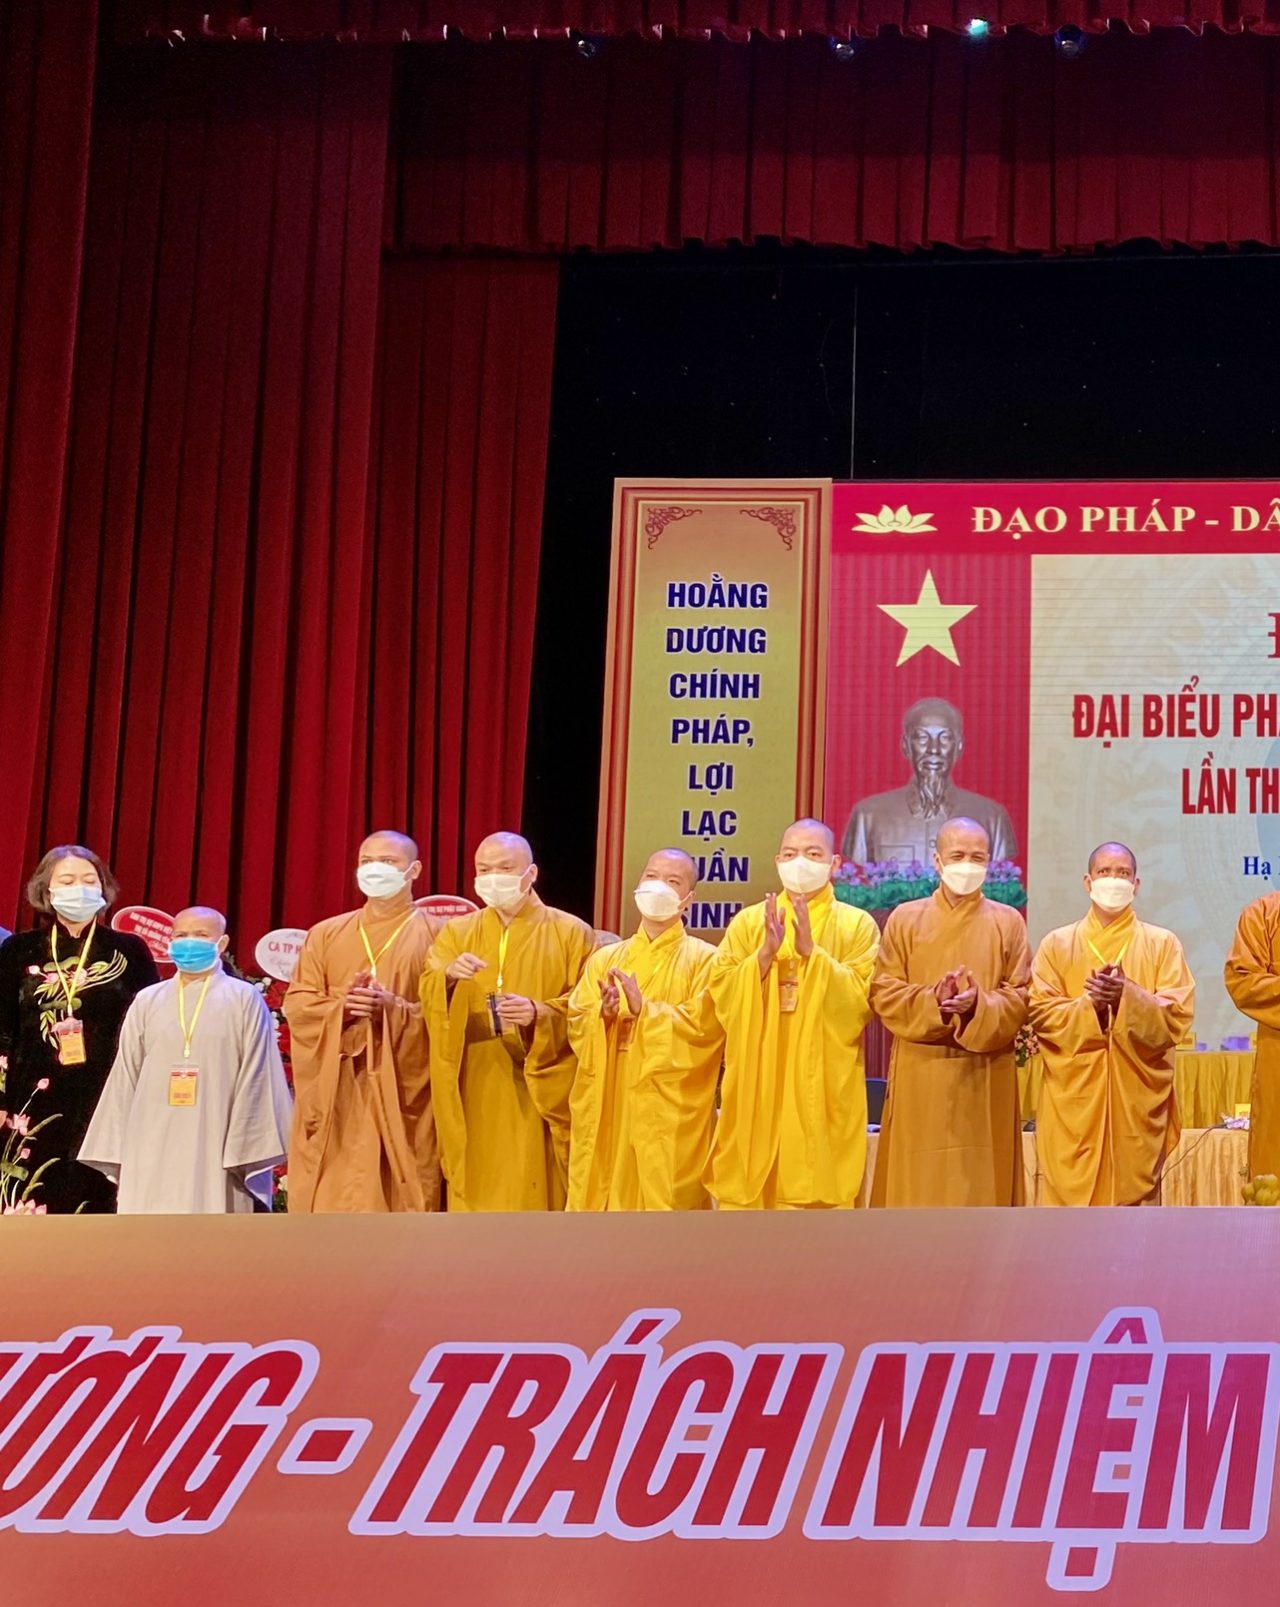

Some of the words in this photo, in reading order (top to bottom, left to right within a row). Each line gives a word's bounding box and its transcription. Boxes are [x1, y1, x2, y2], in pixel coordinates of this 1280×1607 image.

[971, 506, 1067, 540] ĐẠO
[1079, 498, 1196, 533] PHÁP
[667, 573, 768, 608] HOẰNG
[666, 625, 767, 653] DƯƠNG
[669, 669, 760, 699] CHÍNH
[1072, 694, 1130, 748] ĐẠI
[1142, 675, 1220, 738] BIỂU
[671, 714, 754, 747] PHÁP,
[689, 762, 733, 795] LỢI
[1182, 751, 1236, 814] LẦN
[682, 811, 737, 841] LẠC
[1243, 856, 1271, 880] Hạ
[366, 1317, 830, 1529] TRÁCH
[818, 1316, 1271, 1579] NHIỆM
